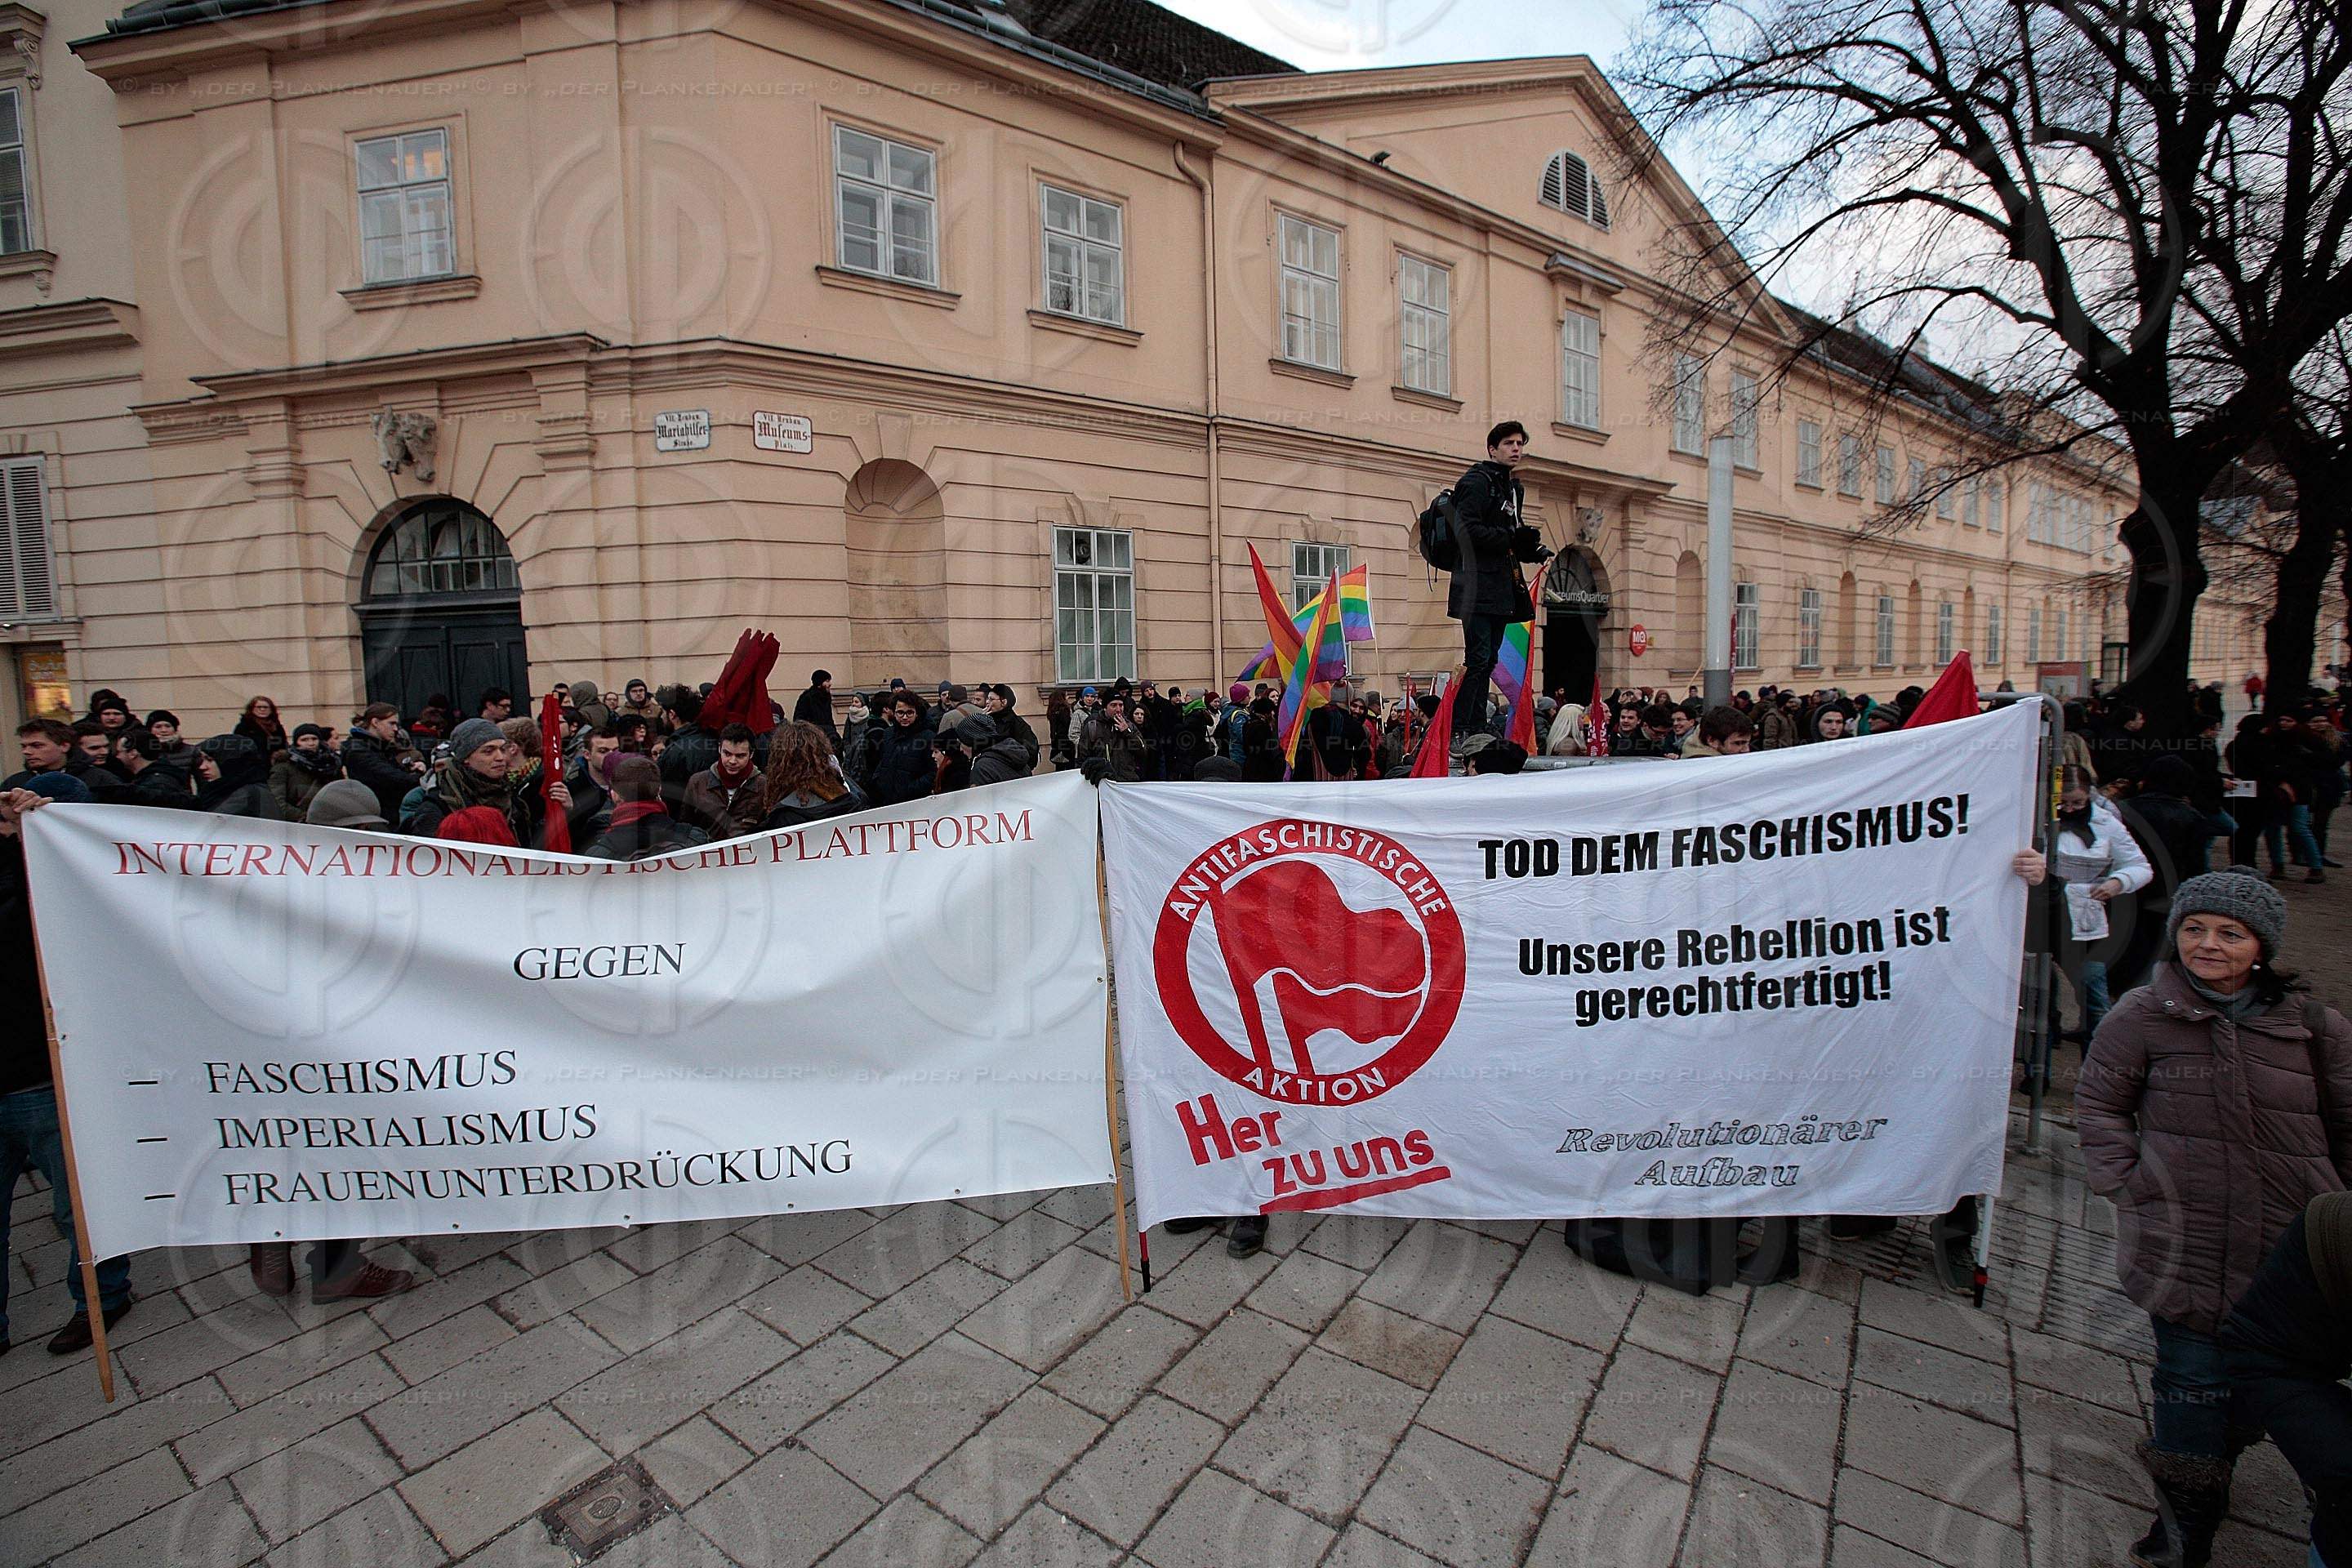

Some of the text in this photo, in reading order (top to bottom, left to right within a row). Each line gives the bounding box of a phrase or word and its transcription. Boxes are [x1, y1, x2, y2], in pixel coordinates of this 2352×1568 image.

[1547, 590, 1610, 604] eumsQuartier
[1632, 631, 1646, 643] MQ
[770, 808, 1035, 863] PLATTFORM
[1478, 793, 1970, 880] TOD DEM FASCHISMUS!
[1169, 822, 1447, 922] ANTIFASCHISTISCHE
[514, 943, 687, 980] GEGEN
[1517, 906, 1951, 977] Unsere Rebellion ist
[1575, 960, 1892, 1028] gerechtfertigt!
[203, 1049, 517, 1094] FASCHISMUS
[1243, 1067, 1387, 1102] AKTION
[214, 1103, 596, 1150] IMPERIALISMUS
[1175, 1093, 1282, 1166] Her
[1556, 1114, 1888, 1154] Revolutionärer
[222, 1138, 853, 1205] FRAUENUNTERDRÜCKUNG
[1334, 1129, 1435, 1179] uns
[1634, 1156, 1802, 1187] Aufbau
